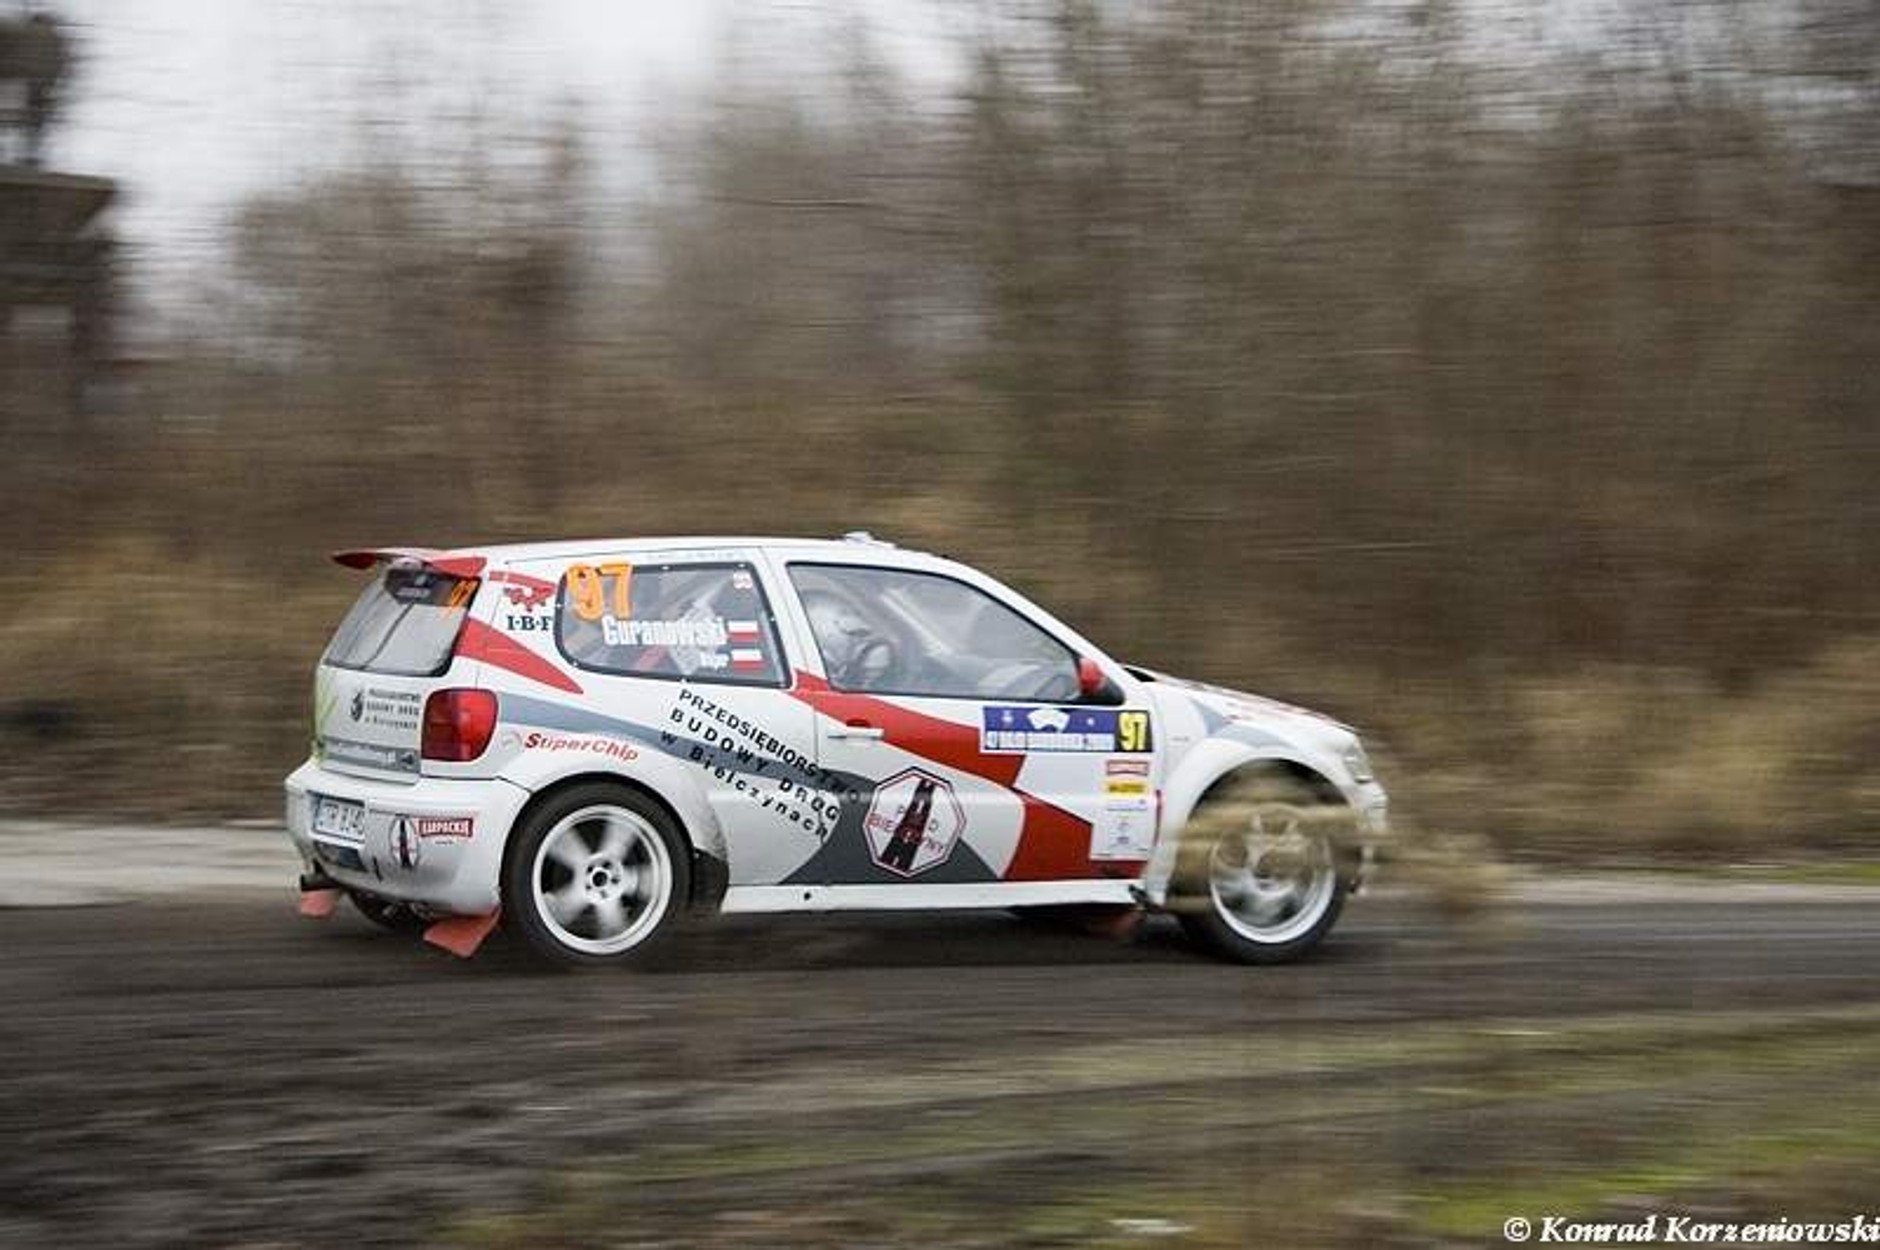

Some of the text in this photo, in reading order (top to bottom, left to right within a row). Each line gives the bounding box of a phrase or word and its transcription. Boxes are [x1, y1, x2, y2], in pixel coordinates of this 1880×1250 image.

[566, 562, 633, 620] 97
[525, 733, 639, 761] SuperChip
[670, 708, 769, 772] BUDOWY
[1118, 711, 1149, 751] 97
